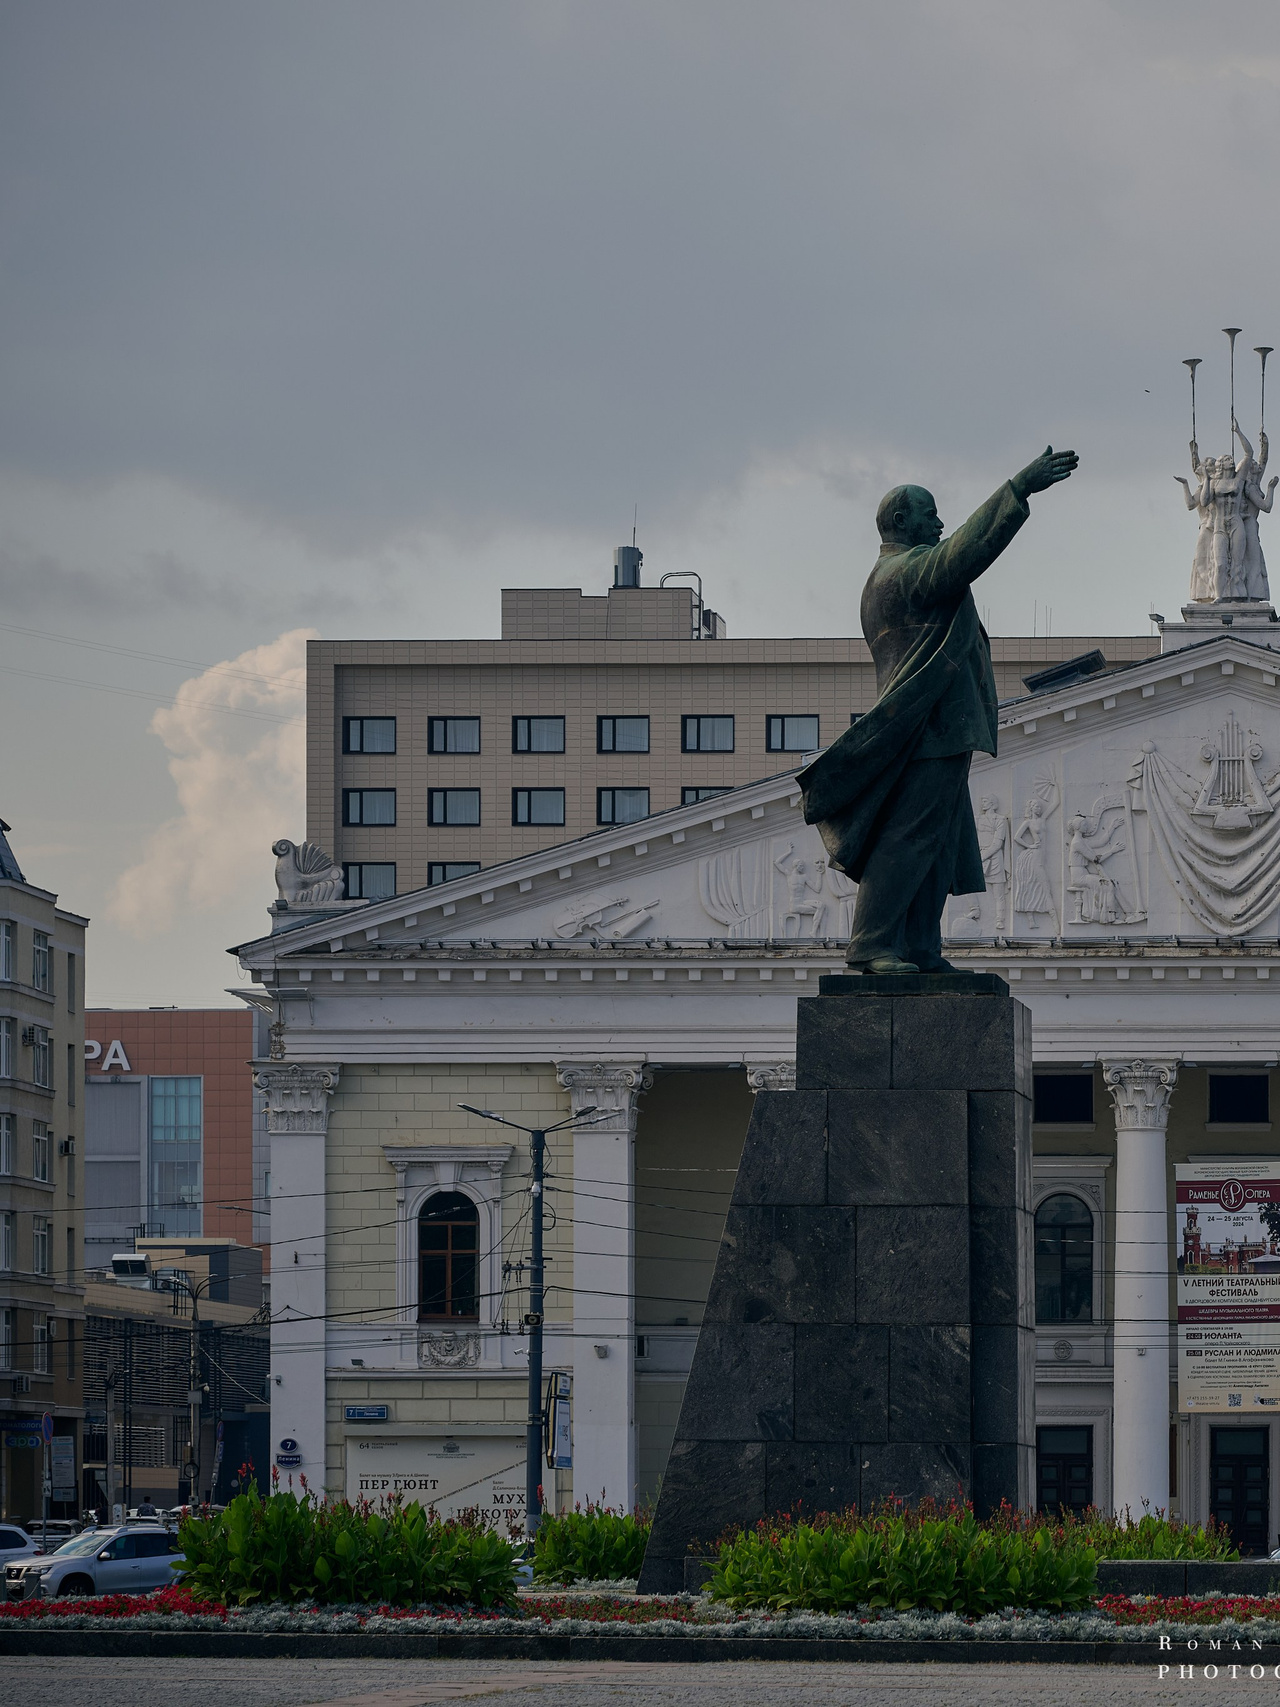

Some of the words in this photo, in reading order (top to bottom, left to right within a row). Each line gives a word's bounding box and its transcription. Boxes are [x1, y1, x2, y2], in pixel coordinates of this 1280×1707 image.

[85, 1039, 131, 1071] РА
[1183, 1279, 1189, 1287] V
[1191, 1277, 1224, 1287] ЛЕТНИЙ
[1208, 1288, 1259, 1297] ФЕСТИВАЛЬ
[359, 1480, 390, 1490] ПЕР
[393, 1479, 439, 1490] ГЮНТ
[492, 1494, 526, 1504] МУХ
[457, 1509, 528, 1519] ЦОКОТУХ
